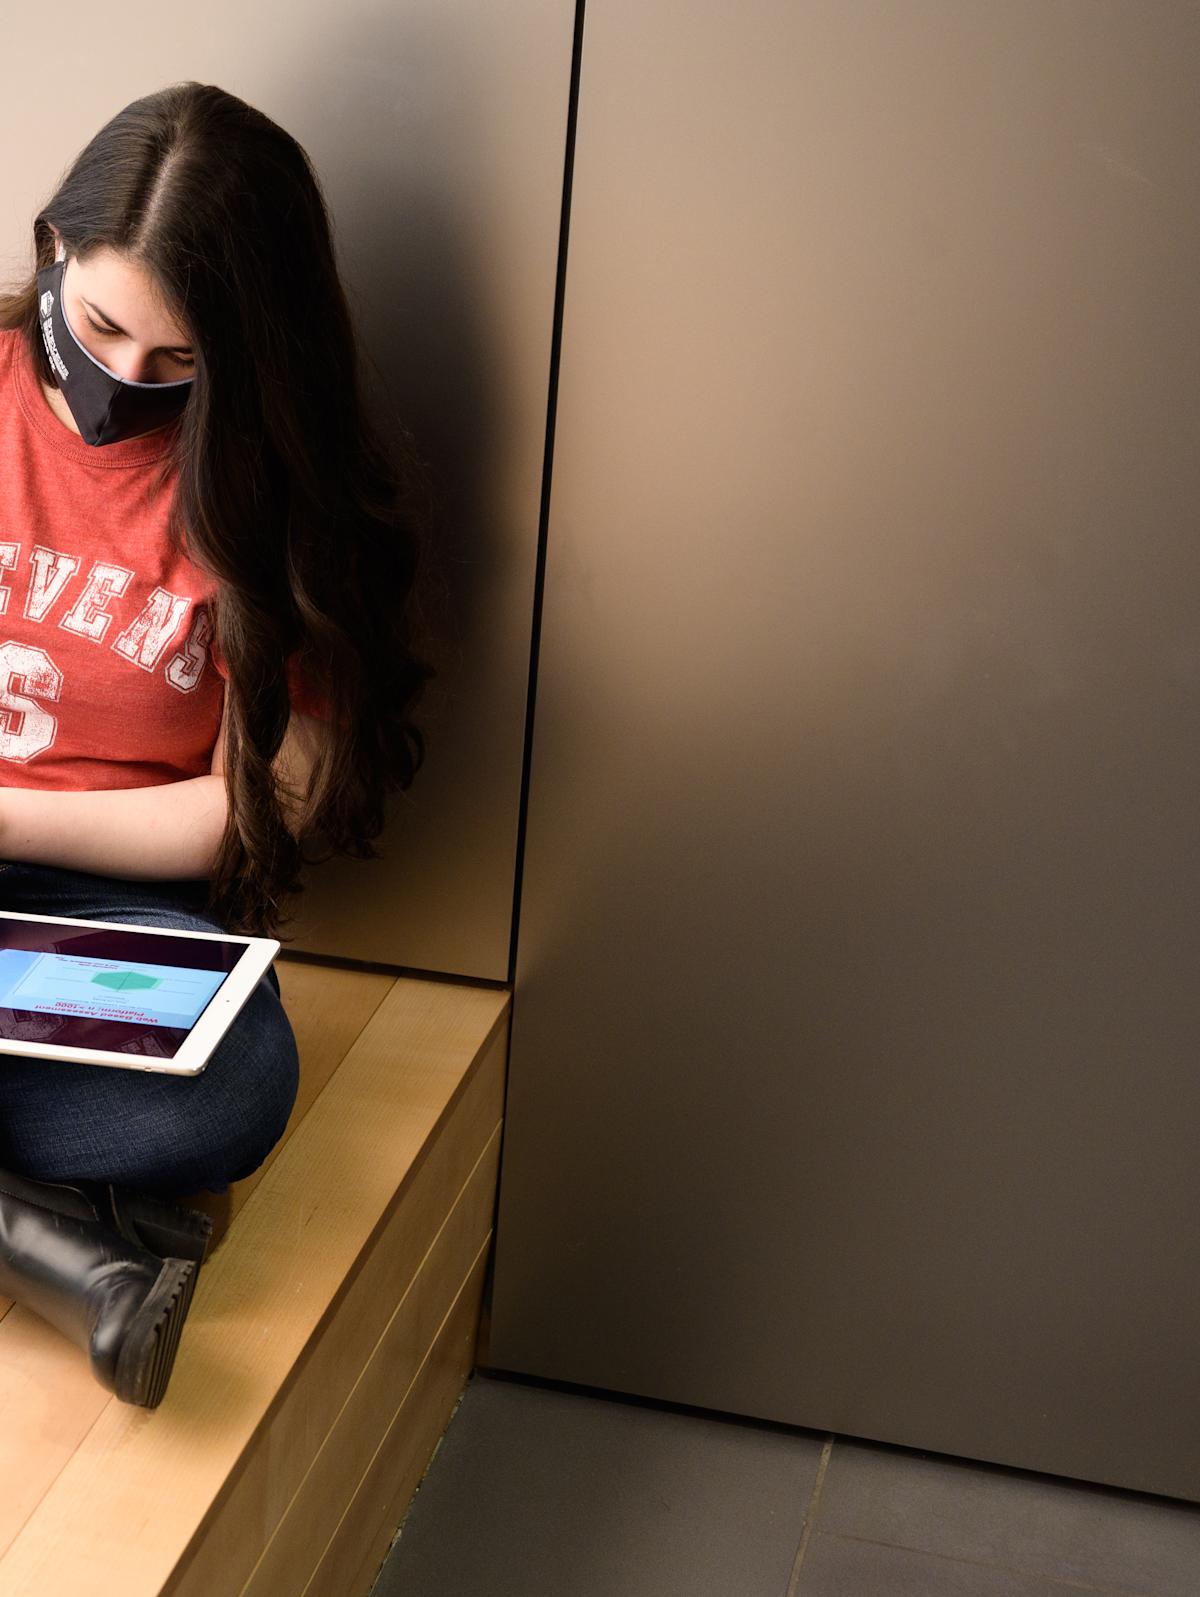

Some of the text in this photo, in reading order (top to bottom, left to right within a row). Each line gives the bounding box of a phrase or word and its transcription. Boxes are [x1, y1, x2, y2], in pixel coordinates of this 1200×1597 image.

[34, 1004, 159, 1024] Web Based Assessment
